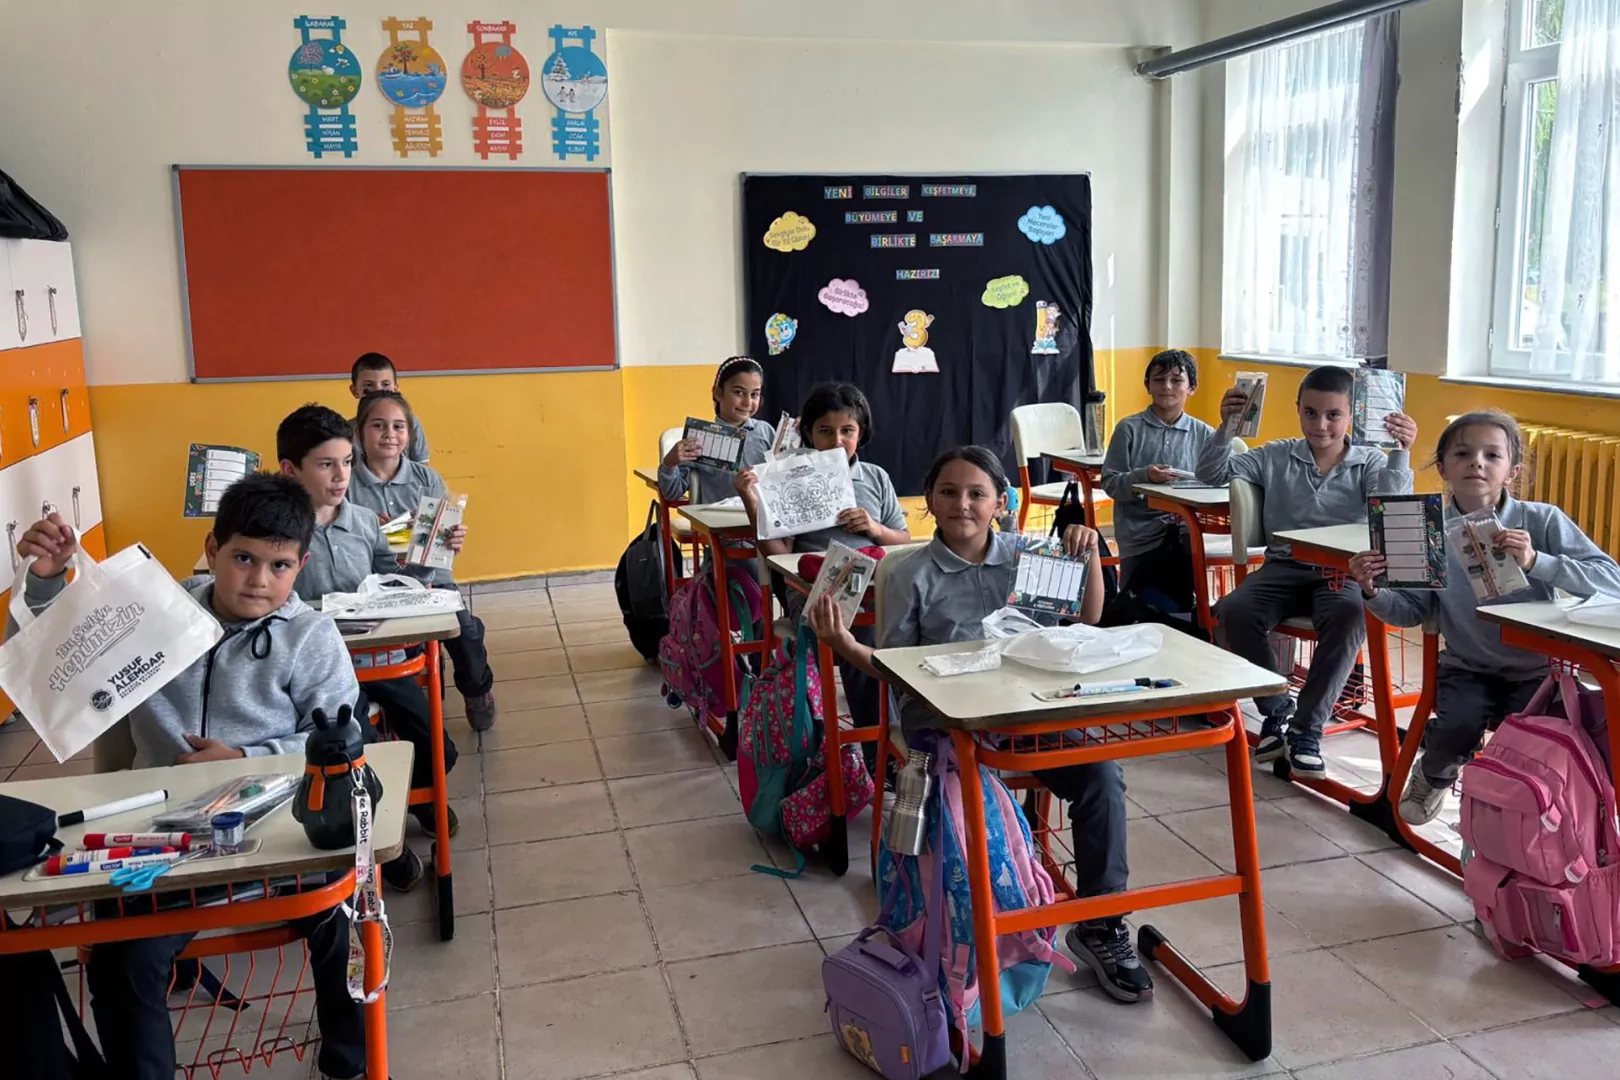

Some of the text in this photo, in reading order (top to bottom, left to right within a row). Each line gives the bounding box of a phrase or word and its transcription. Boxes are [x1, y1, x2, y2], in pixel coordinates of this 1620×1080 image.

[824, 186, 853, 199] YENİ
[865, 186, 908, 197] BİLGİLER
[845, 211, 923, 223] BÜYÜMEYE VE
[871, 233, 984, 248] BİRLİKTE BAŞARMAYA
[896, 269, 940, 280] HAZIRIZ!
[49, 602, 145, 692] Hepimizin
[107, 655, 143, 685] YUSUF
[115, 651, 166, 693] ALEMDAR
[359, 811, 369, 845] Rabbit
